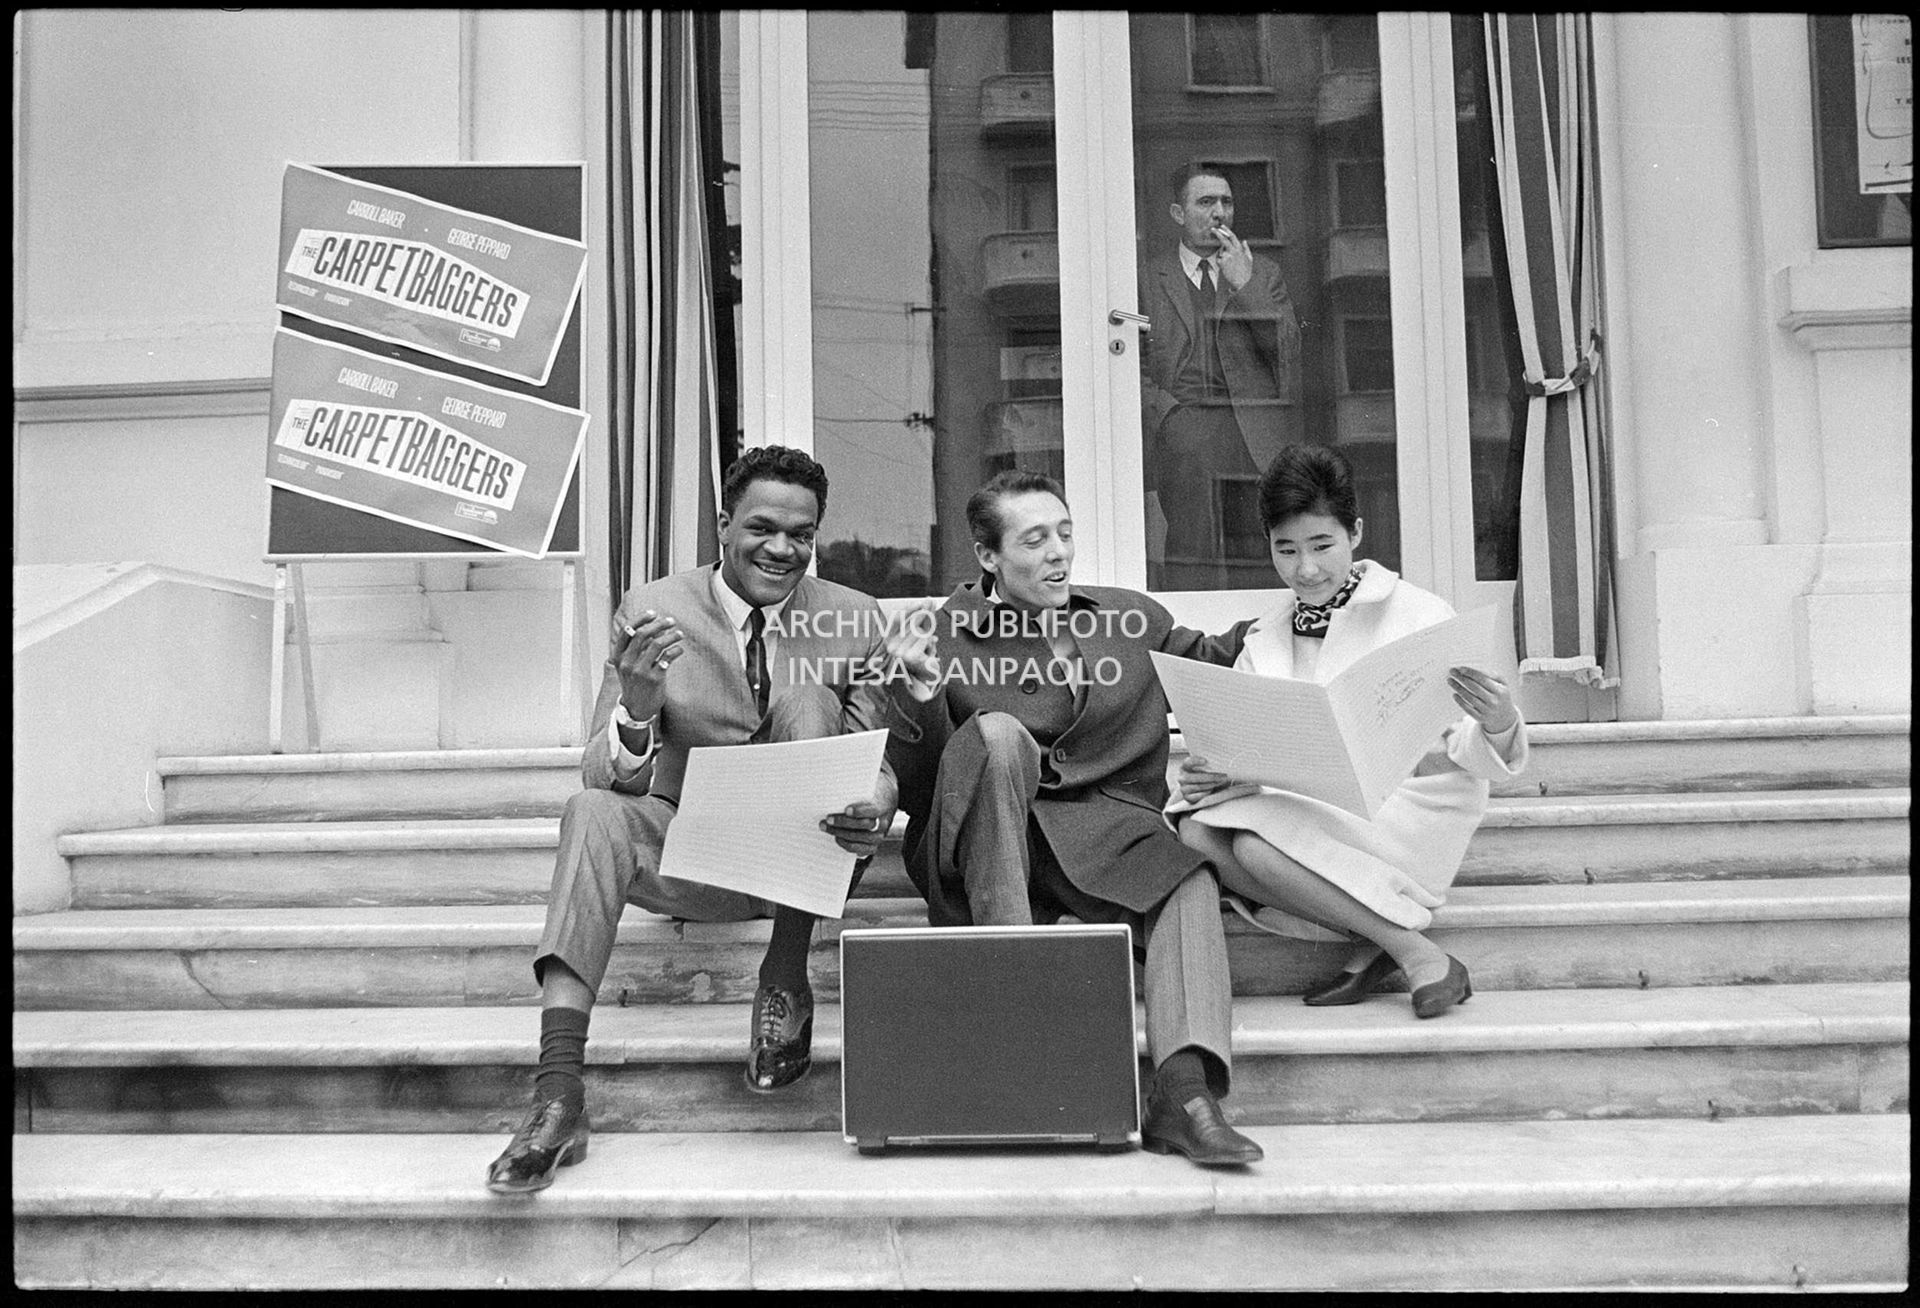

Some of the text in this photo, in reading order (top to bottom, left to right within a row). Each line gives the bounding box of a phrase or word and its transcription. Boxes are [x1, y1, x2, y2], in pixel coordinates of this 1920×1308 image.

[347, 199, 406, 229] CARROLL BAKER
[447, 228, 511, 260] GEORGE PEPPARD
[302, 236, 518, 328] THE CARPETBAGGERS
[337, 367, 399, 399] CARROLL BAKER
[441, 397, 507, 429] GEORGE PEPPARD
[292, 406, 514, 499] THE CARPETBAGGERS
